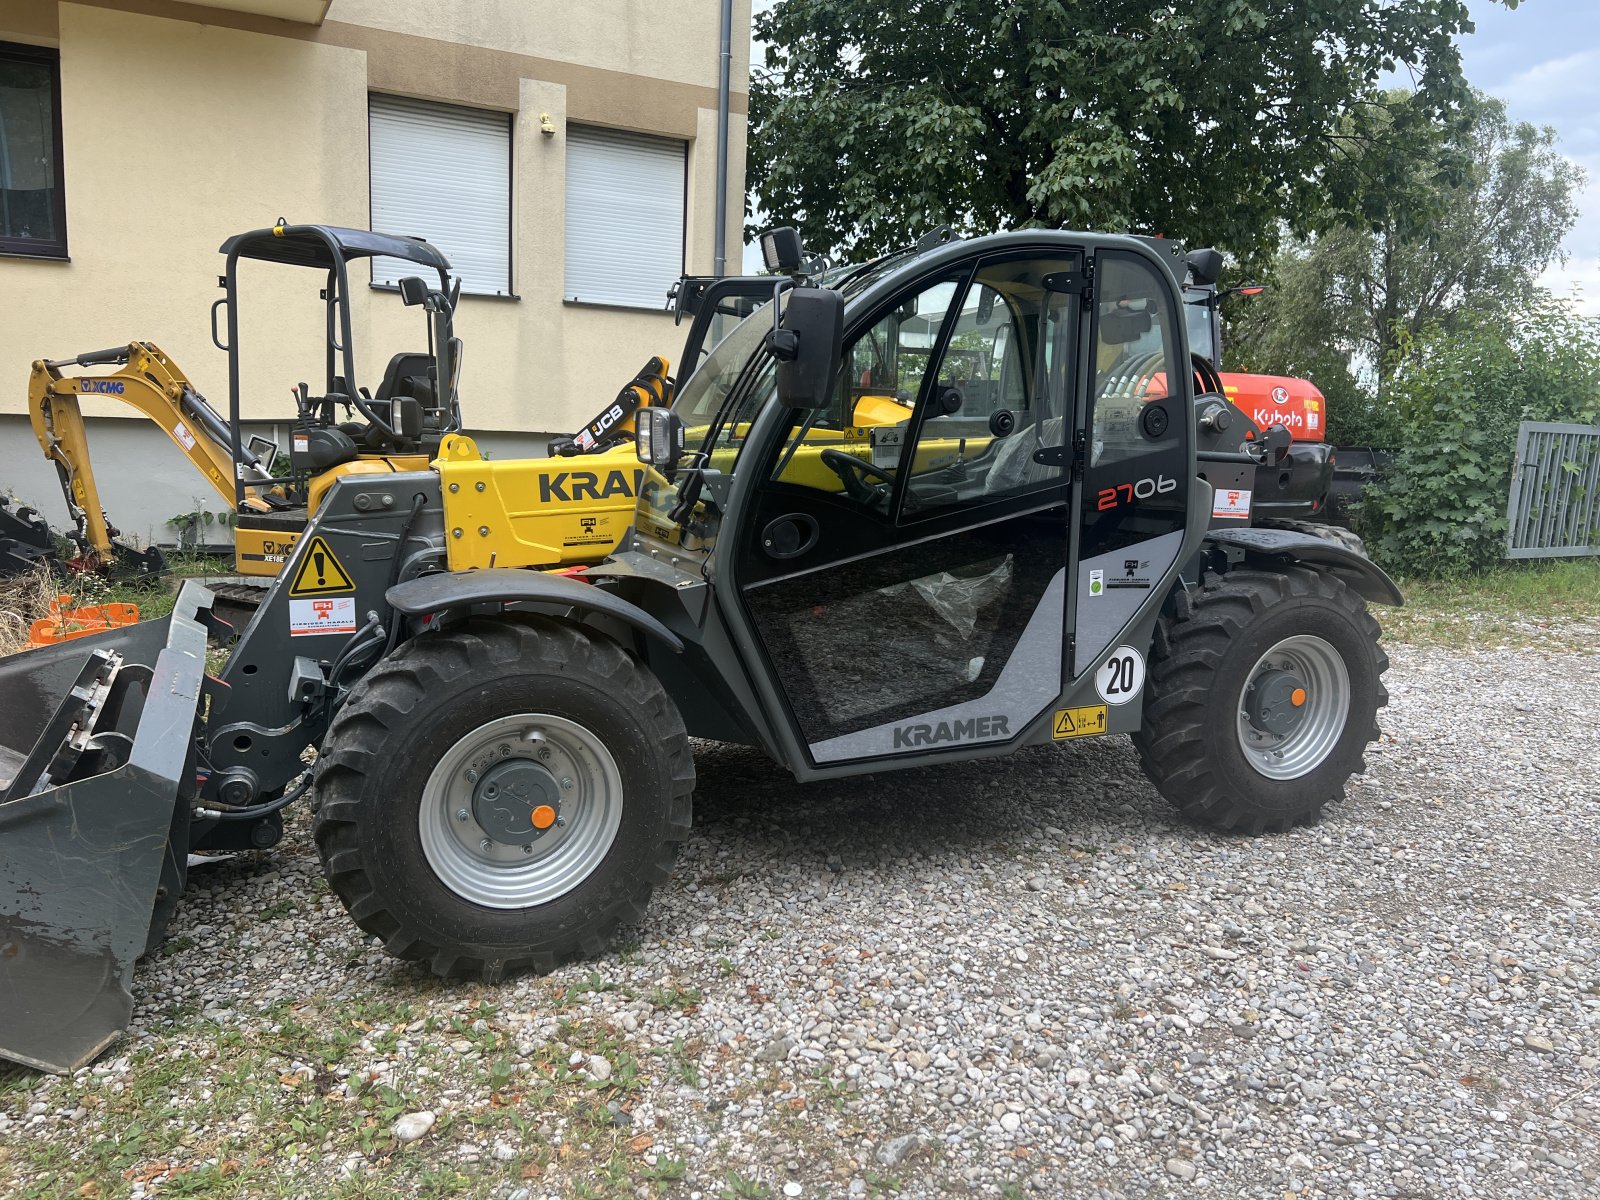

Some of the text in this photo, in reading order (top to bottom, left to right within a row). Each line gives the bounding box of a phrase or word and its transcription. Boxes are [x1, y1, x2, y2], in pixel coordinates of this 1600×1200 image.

[93, 380, 125, 394] XCMG
[594, 404, 624, 437] JCB
[1253, 408, 1303, 427] Kubota
[1097, 474, 1177, 511] 2706
[264, 554, 284, 563] XE18E
[1106, 656, 1134, 694] 20
[893, 715, 1011, 749] KRAMER
